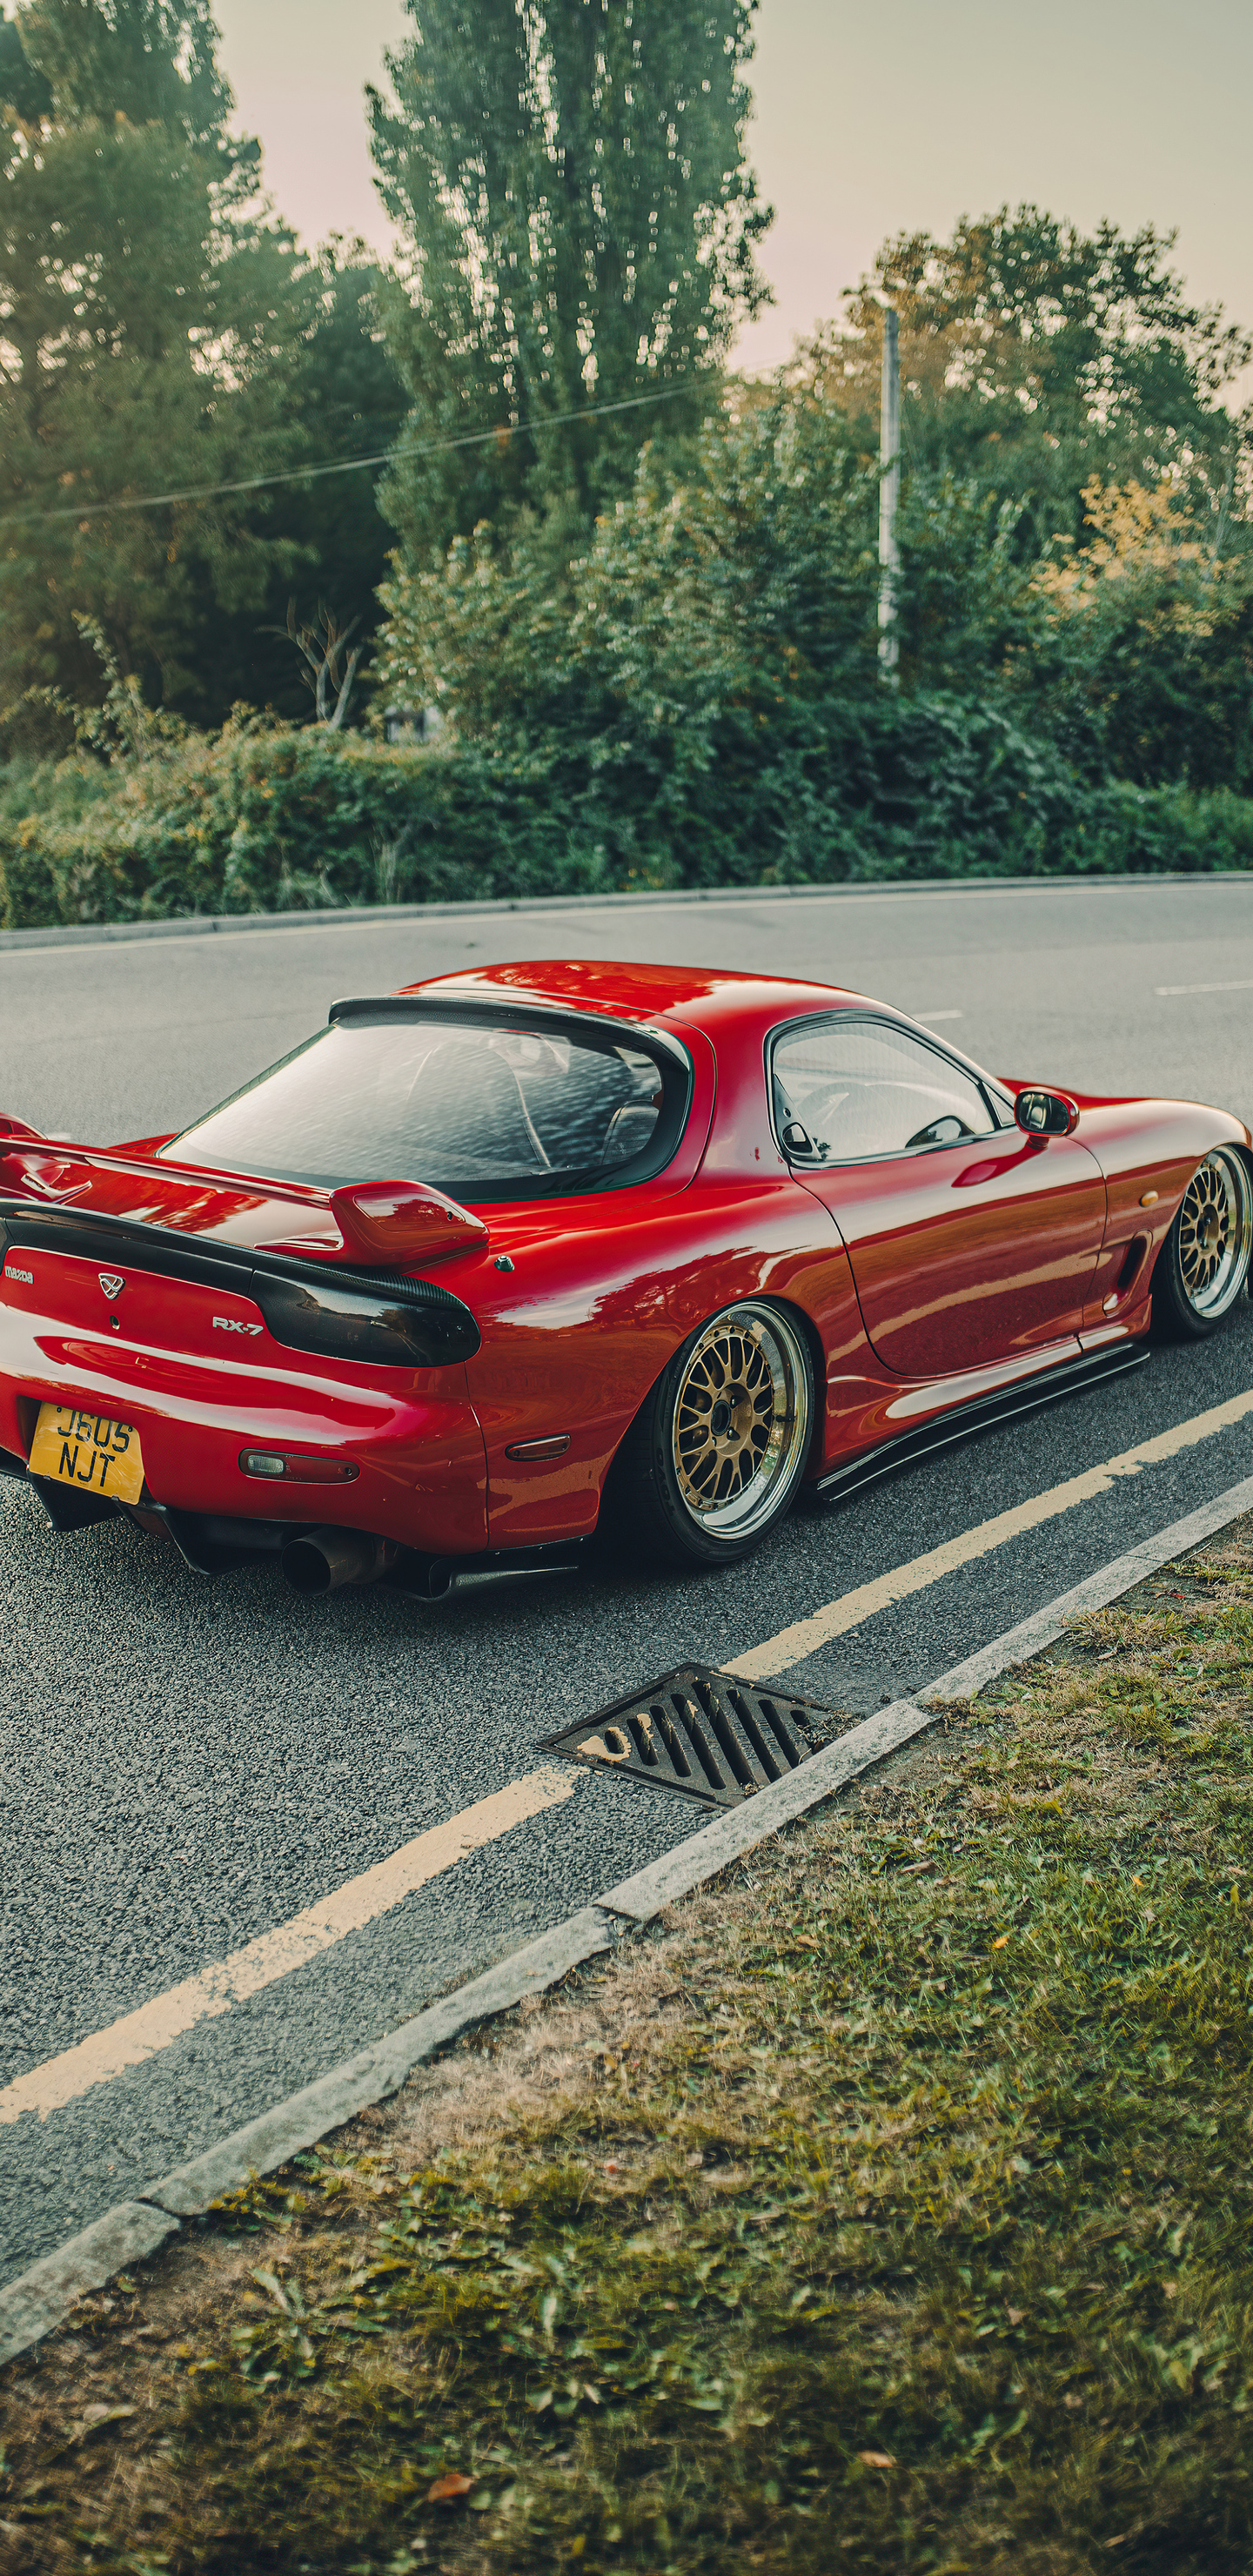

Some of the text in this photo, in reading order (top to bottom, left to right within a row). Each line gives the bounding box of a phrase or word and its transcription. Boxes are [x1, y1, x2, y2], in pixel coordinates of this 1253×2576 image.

[212, 1316, 264, 1336] RX-7
[57, 1410, 130, 1452] J605
[58, 1441, 116, 1487] NJT
